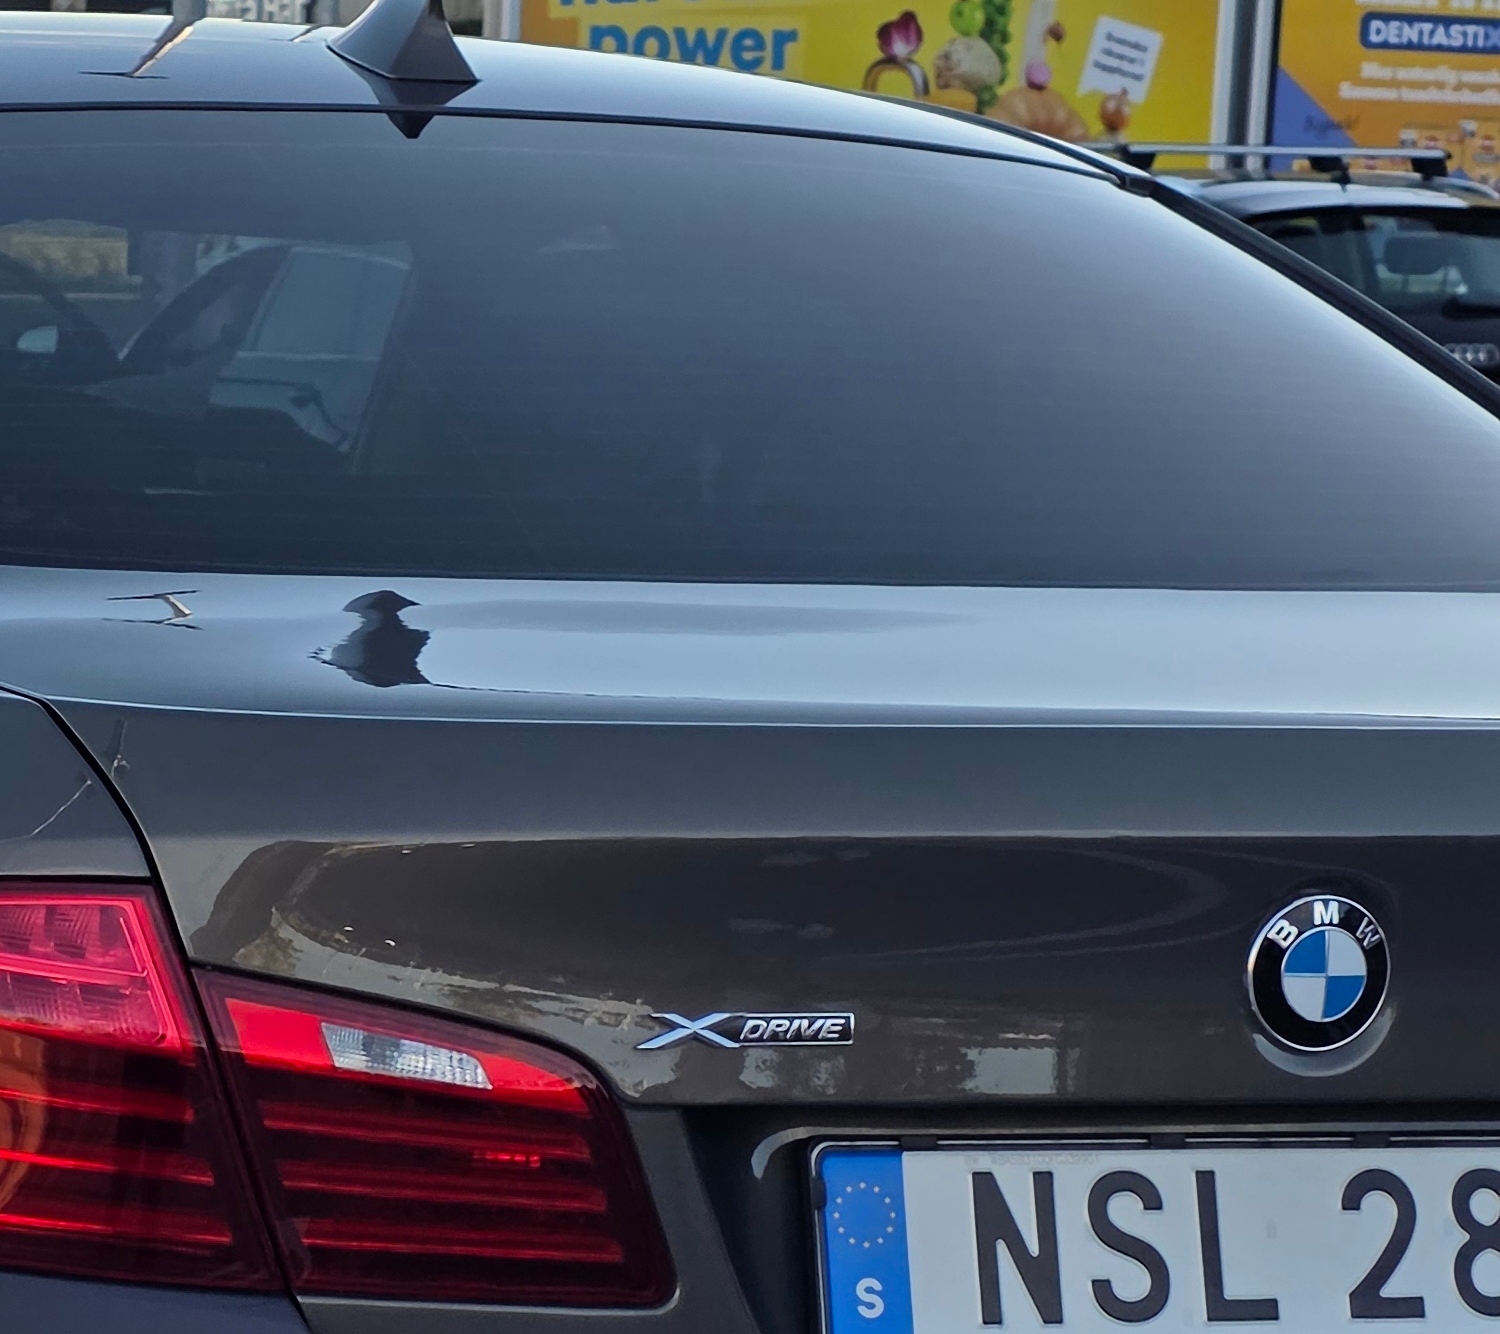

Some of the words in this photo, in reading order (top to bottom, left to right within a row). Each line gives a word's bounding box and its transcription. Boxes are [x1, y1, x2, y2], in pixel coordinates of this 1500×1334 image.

[1266, 900, 1381, 950] BMW
[971, 1169, 1280, 1326] NSL
[1340, 1168, 1500, 1319] 28
[855, 1277, 885, 1319] S
